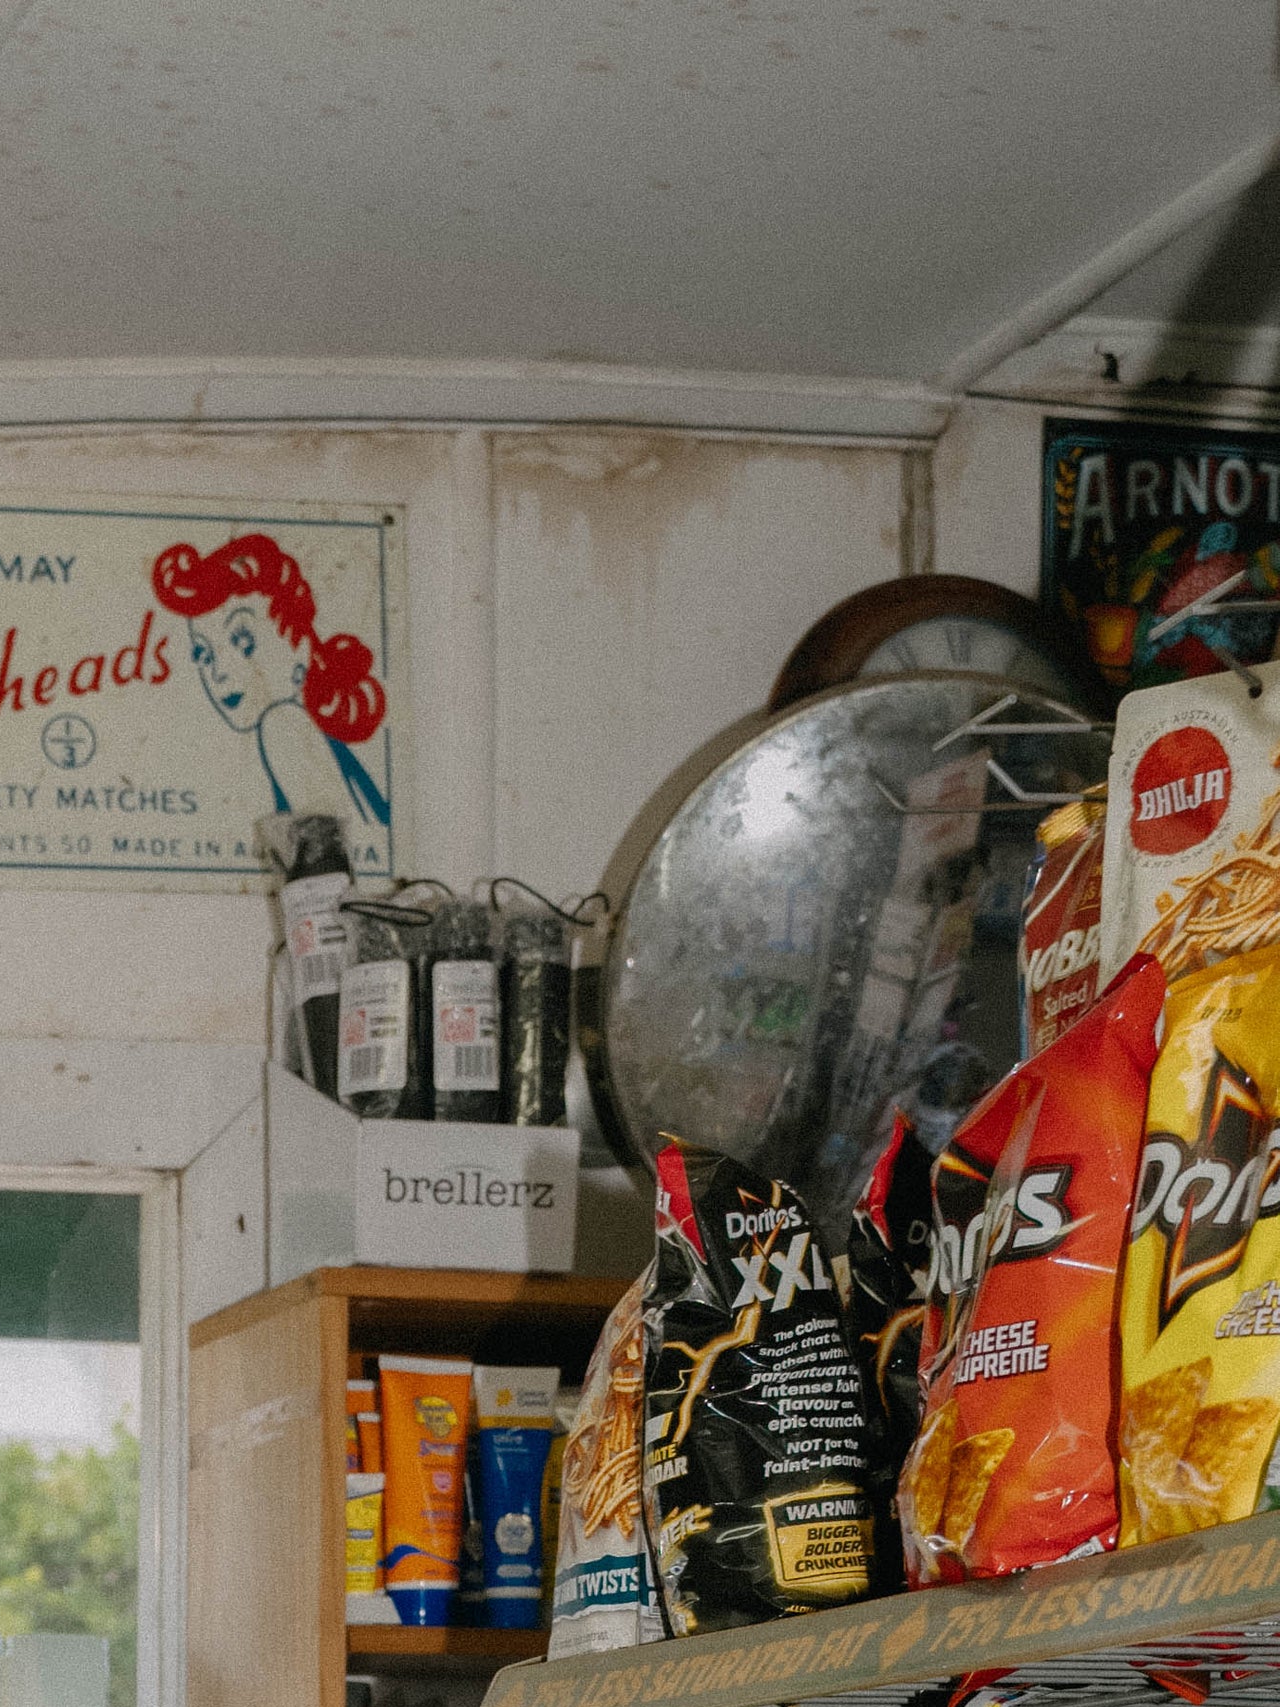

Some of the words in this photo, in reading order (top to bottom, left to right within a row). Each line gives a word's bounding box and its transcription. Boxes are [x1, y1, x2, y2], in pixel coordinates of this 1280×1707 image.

[56, 785, 200, 815] MATCHES
[1137, 768, 1226, 822] BHUJA
[60, 840, 94, 856] 50
[112, 838, 182, 858] MADE
[195, 843, 221, 858] IN
[1043, 979, 1089, 1021] Salted
[383, 1168, 556, 1210] brellerz
[731, 1232, 833, 1313] XXL
[758, 1340, 799, 1358] snack
[800, 1333, 831, 1349] that
[773, 1330, 795, 1343] The
[750, 1364, 848, 1384] gargantuan
[772, 1351, 818, 1372] others
[761, 1380, 834, 1398] intense
[777, 1397, 840, 1416] flavour
[767, 1414, 808, 1434] epic
[786, 1438, 824, 1455] NOT
[825, 1437, 843, 1452] for
[843, 1437, 860, 1451] the
[577, 1565, 641, 1600] TWISTS
[930, 1605, 1012, 1652] 75%
[1002, 1578, 1108, 1645] LESS
[640, 1636, 818, 1705] SATURATED
[810, 1620, 882, 1673] FAT
